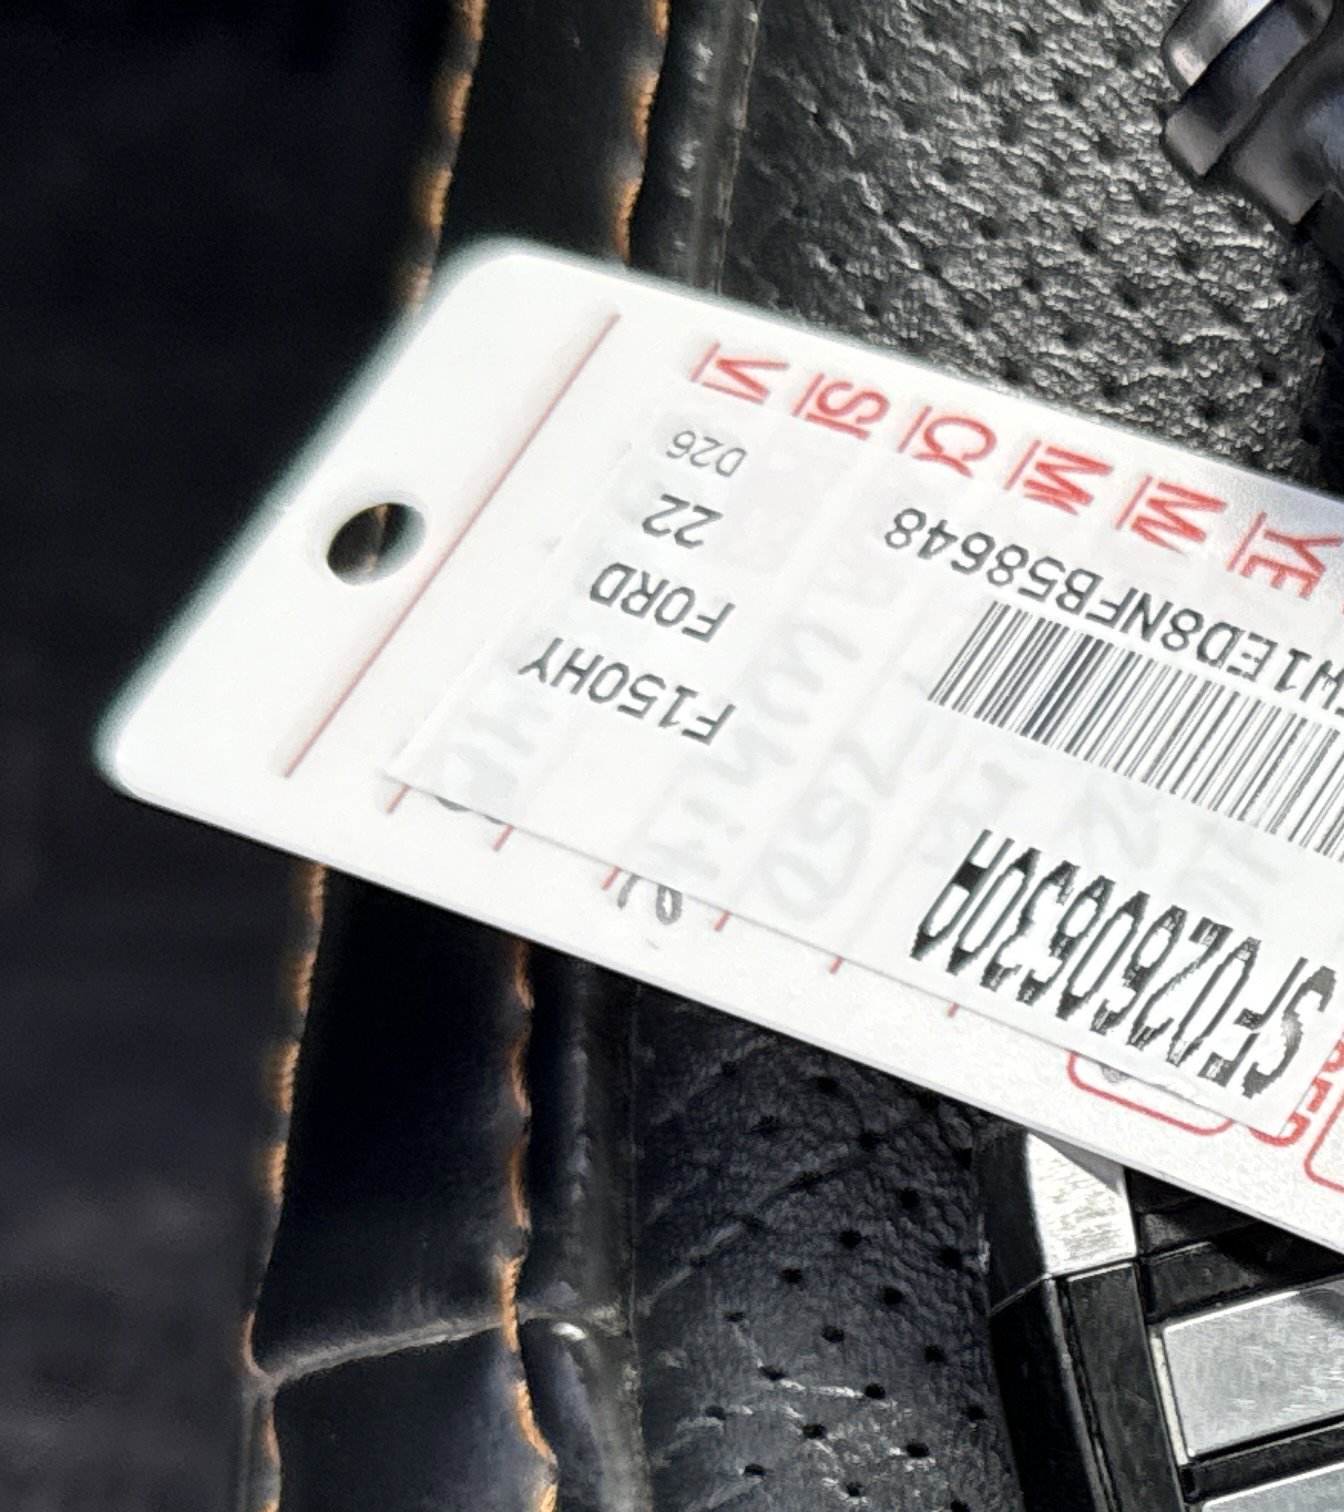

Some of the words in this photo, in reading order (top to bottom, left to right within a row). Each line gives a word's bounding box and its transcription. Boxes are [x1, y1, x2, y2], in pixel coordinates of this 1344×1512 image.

[665, 429, 747, 478] D26
[641, 492, 723, 549] 22
[589, 561, 736, 643] FORD
[518, 636, 737, 746] F150HY
[909, 828, 1337, 1100] SF0260630A
